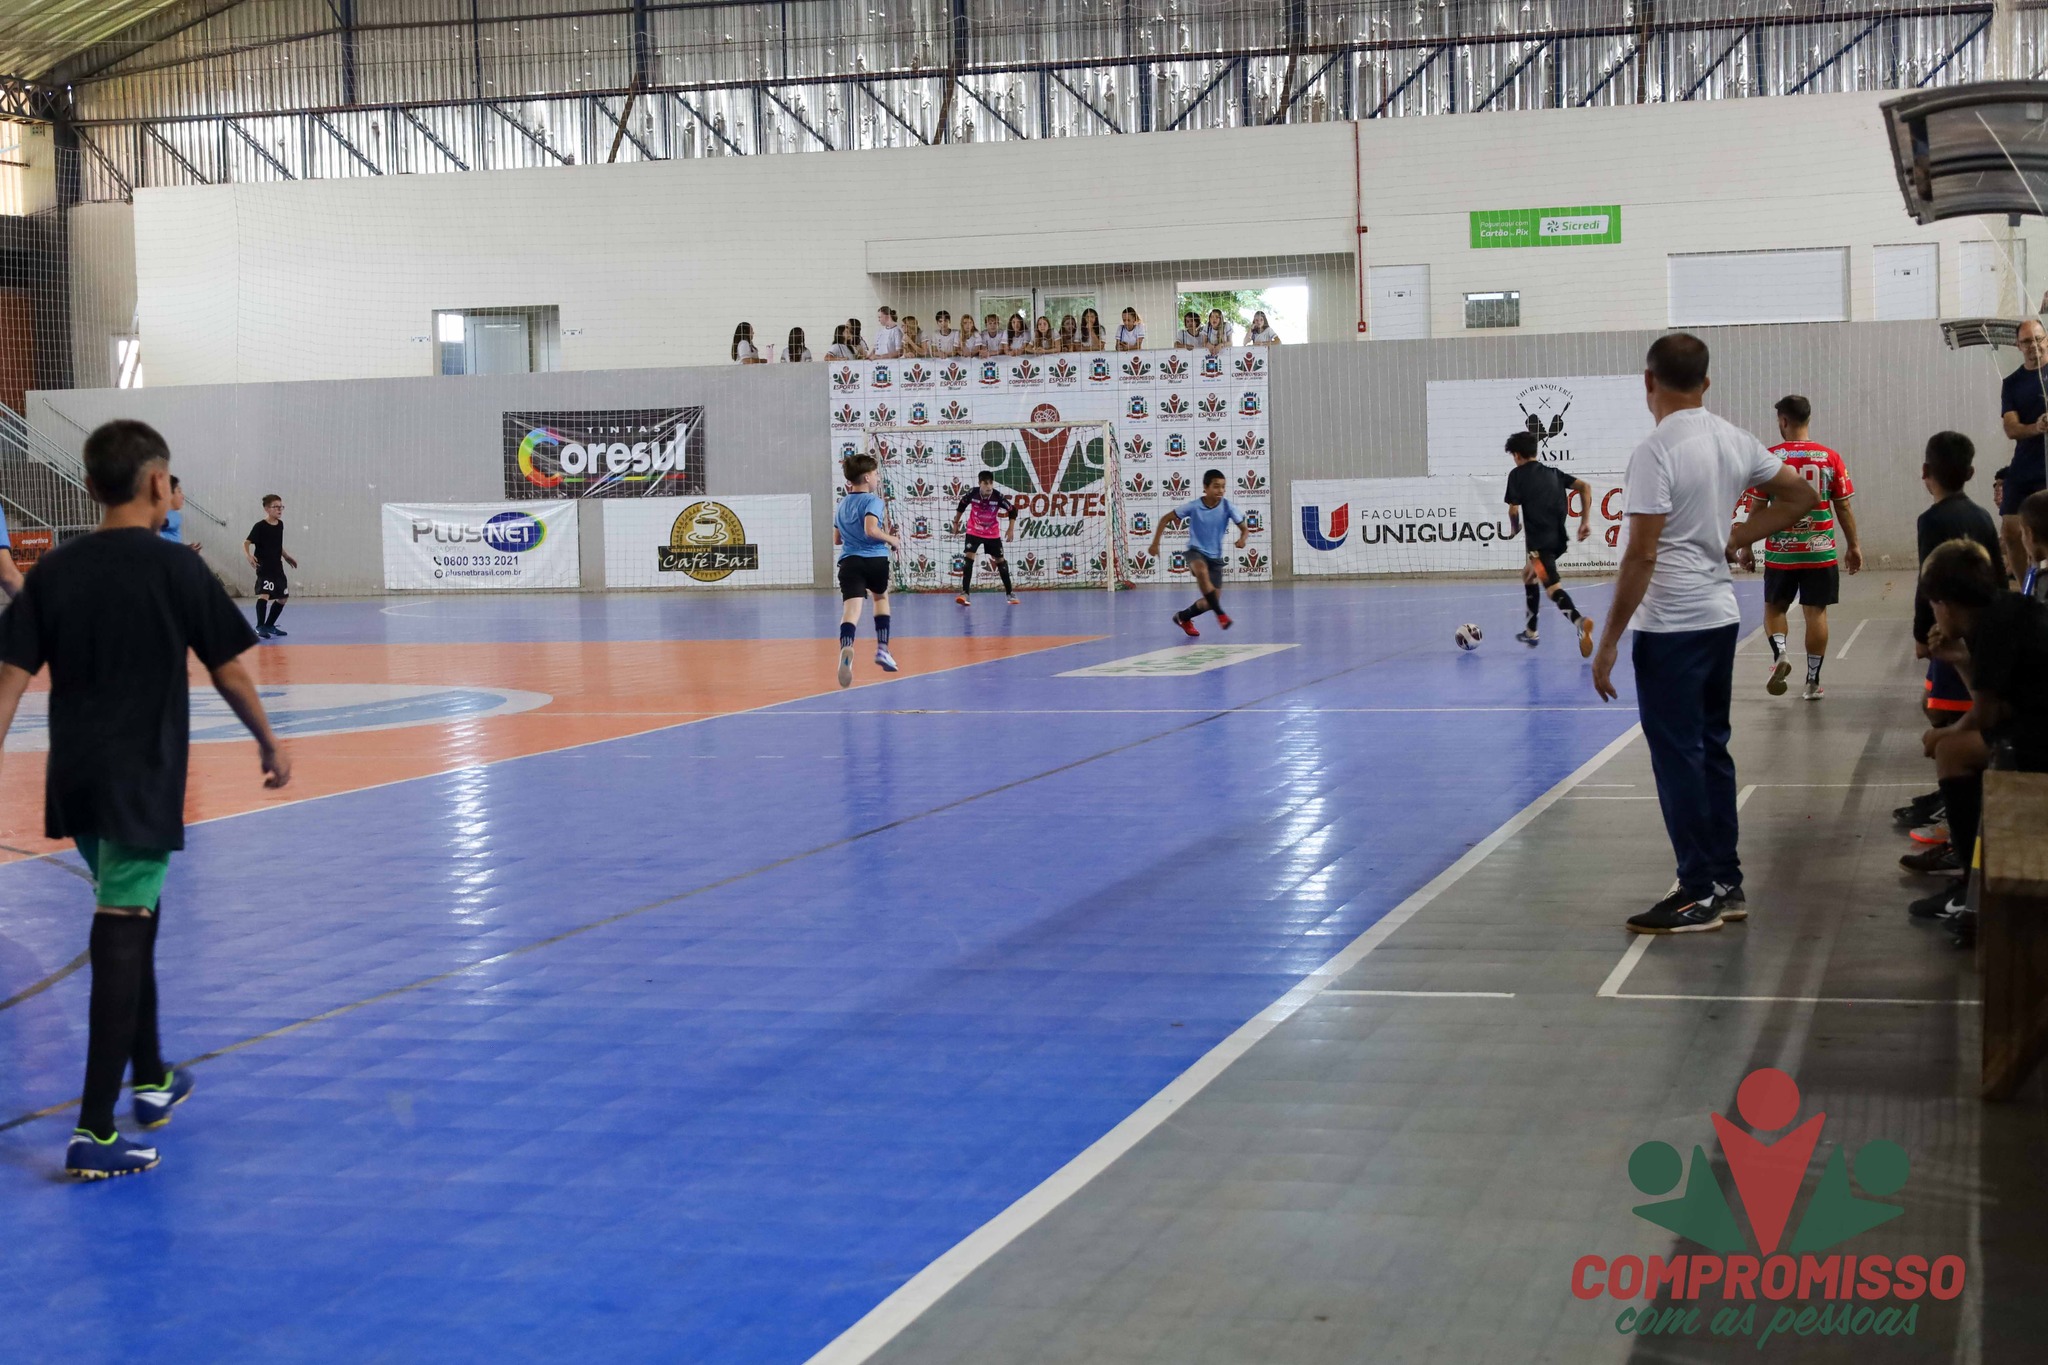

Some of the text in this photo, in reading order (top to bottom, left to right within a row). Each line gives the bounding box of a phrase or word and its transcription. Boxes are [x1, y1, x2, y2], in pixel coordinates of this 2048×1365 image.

[1562, 220, 1600, 230] Sicredi
[587, 425, 661, 434] TINTAS
[518, 423, 687, 488] Coresul
[1539, 450, 1574, 461] ASIL
[1362, 508, 1457, 520] FACULDADE
[1020, 517, 1084, 538] Missal
[444, 556, 518, 566] 0800 333 2021
[663, 553, 752, 576] Café Bar
[263, 580, 274, 590] 20
